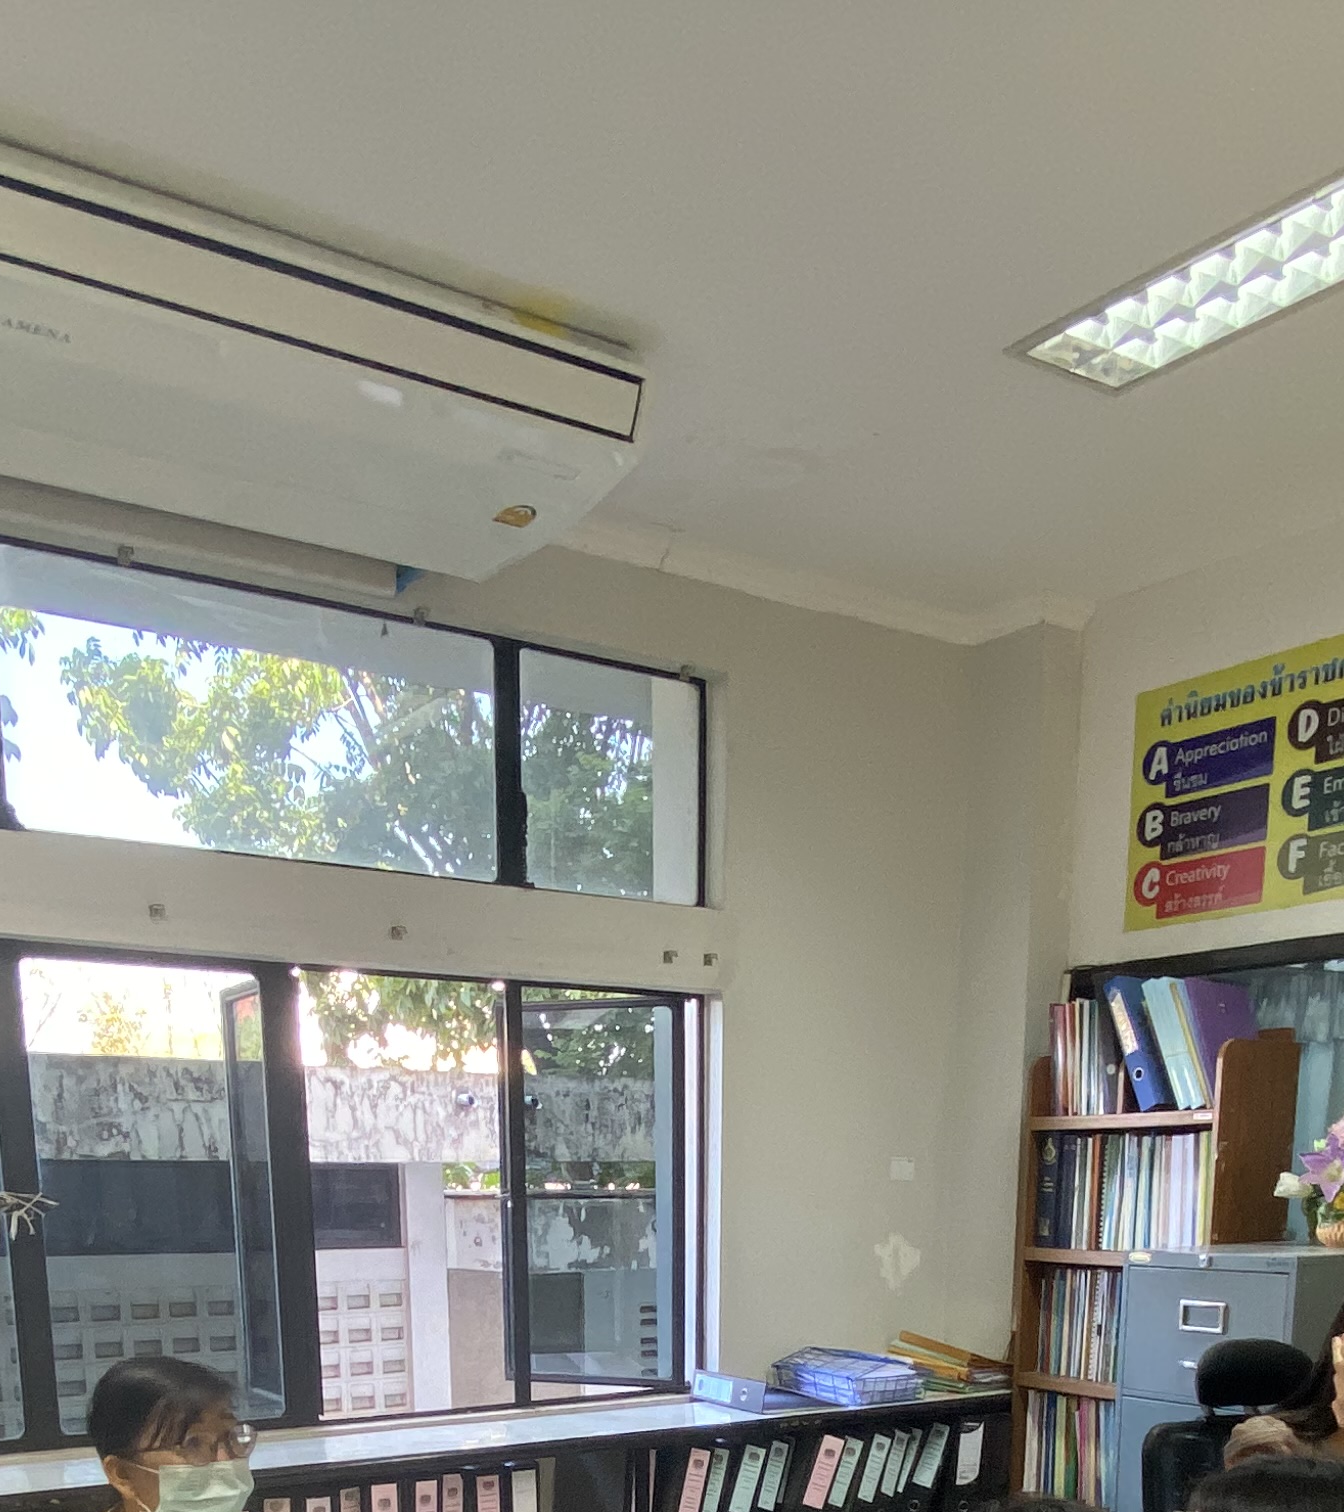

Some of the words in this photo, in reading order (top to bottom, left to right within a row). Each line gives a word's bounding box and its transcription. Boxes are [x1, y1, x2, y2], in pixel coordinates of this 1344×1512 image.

[1297, 708, 1319, 743] D
[1149, 746, 1169, 781] A
[1174, 729, 1269, 766] Appreciation
[1291, 775, 1312, 810] E
[1144, 809, 1165, 841] B
[1170, 804, 1222, 828] Bravery
[1288, 838, 1308, 873] F
[1141, 867, 1161, 899] C
[1165, 862, 1231, 888] Creativity
